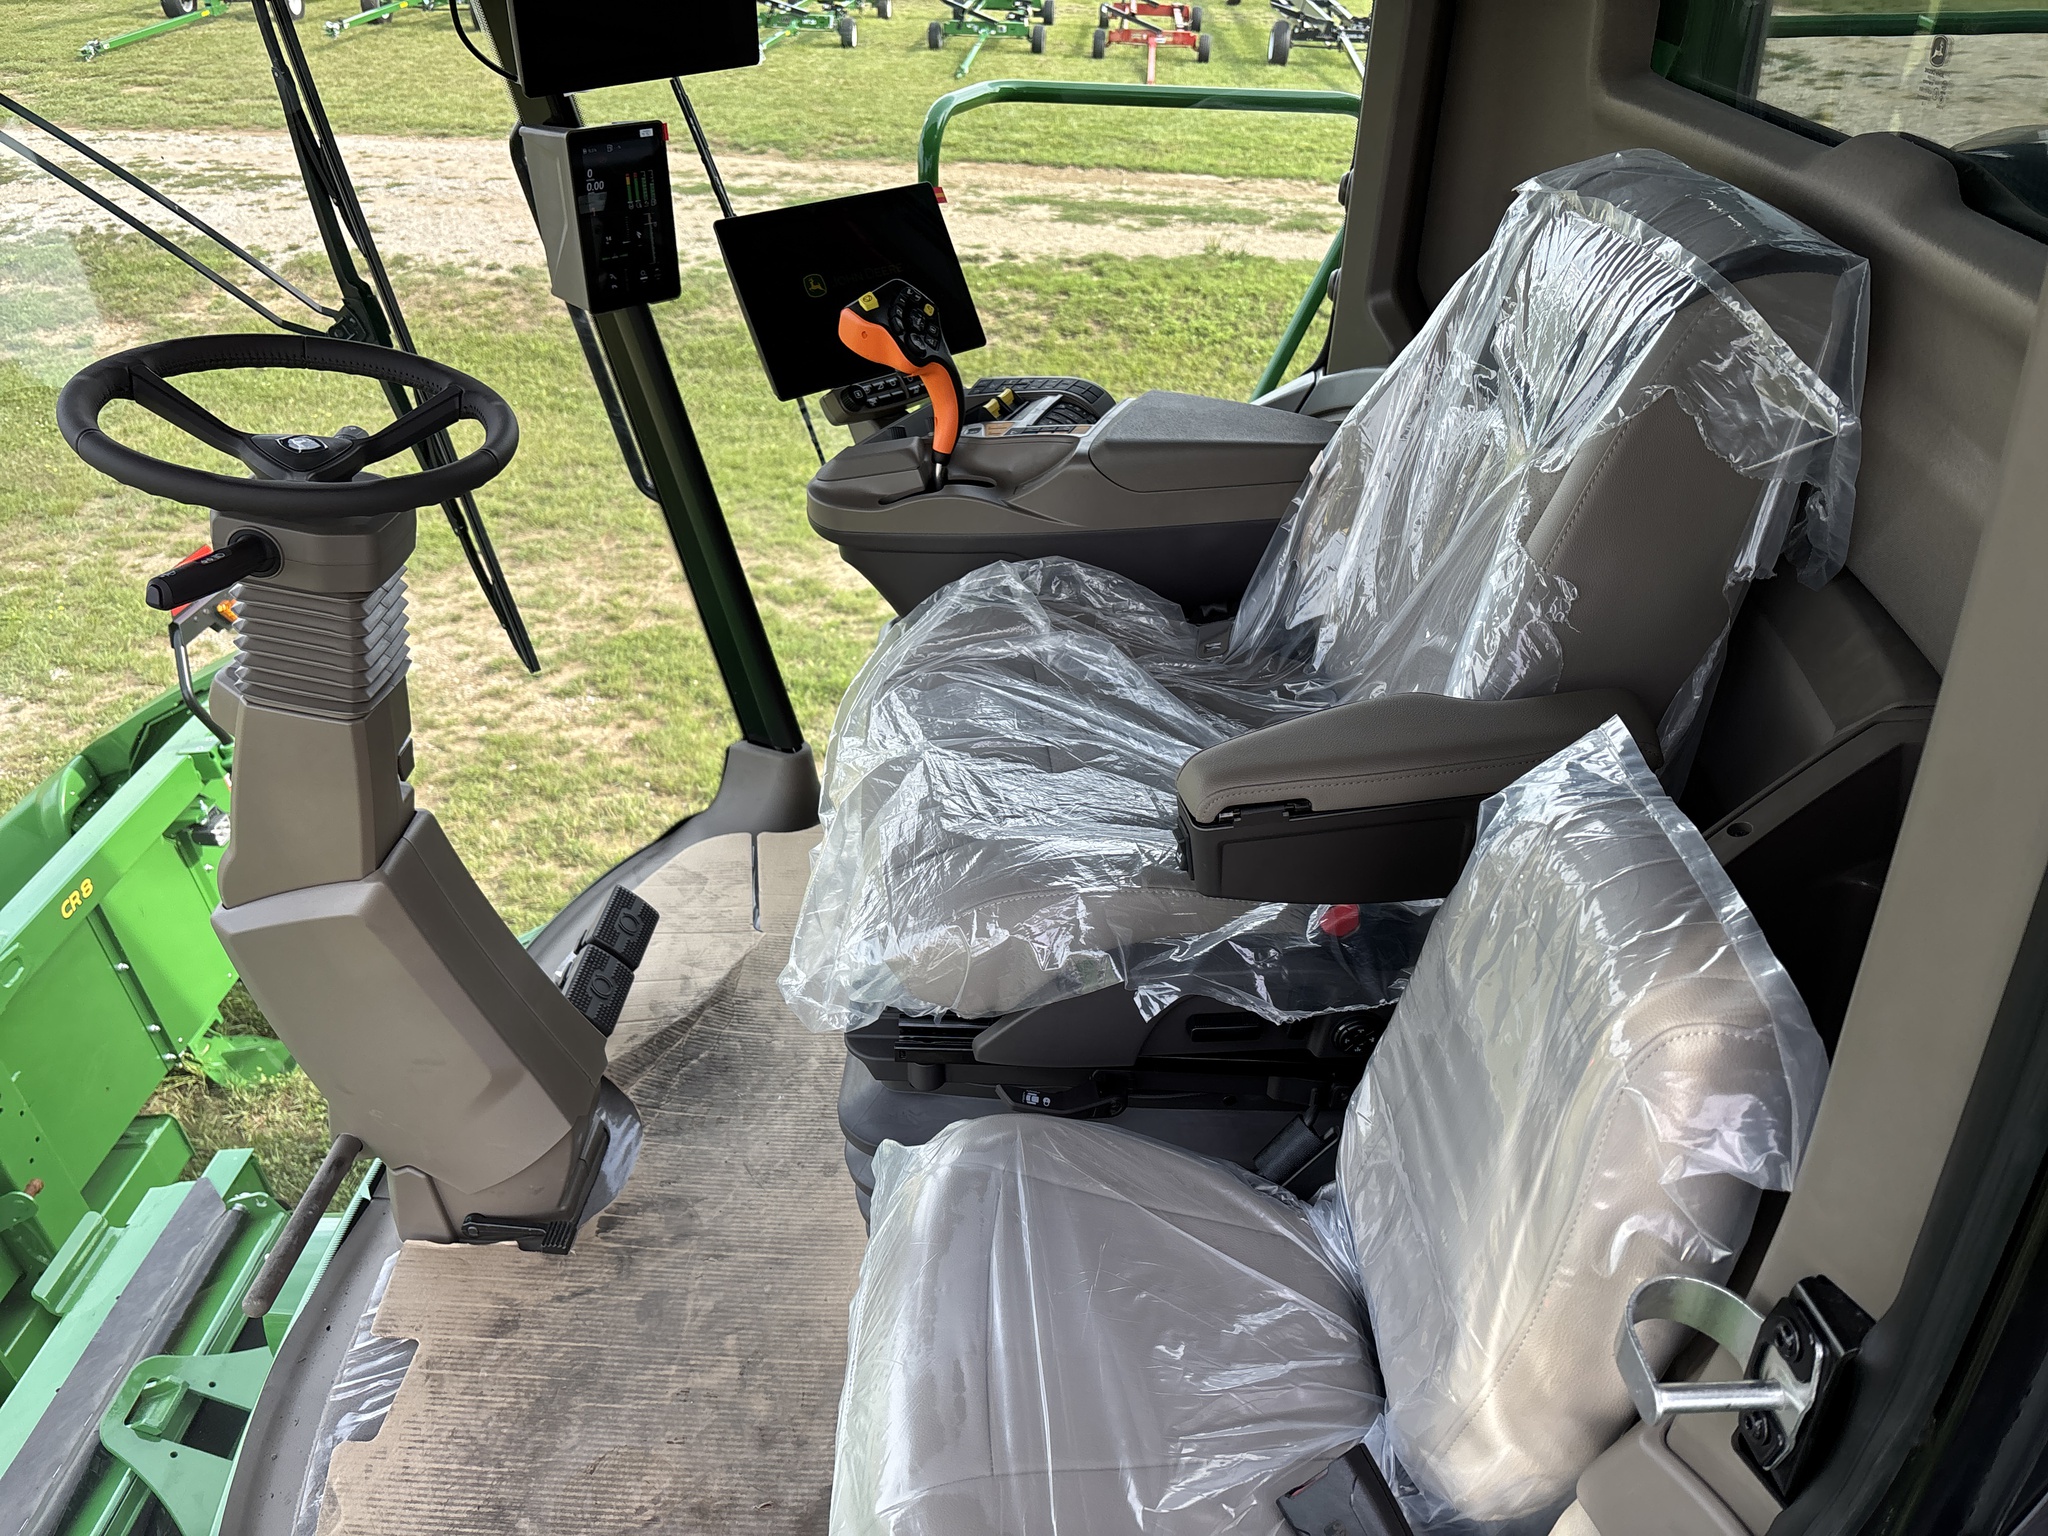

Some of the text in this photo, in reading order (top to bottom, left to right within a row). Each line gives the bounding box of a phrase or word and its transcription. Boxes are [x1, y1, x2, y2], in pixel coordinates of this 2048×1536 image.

[587, 168, 593, 178] 0
[586, 180, 605, 192] 0.00
[864, 262, 904, 280] DEERE
